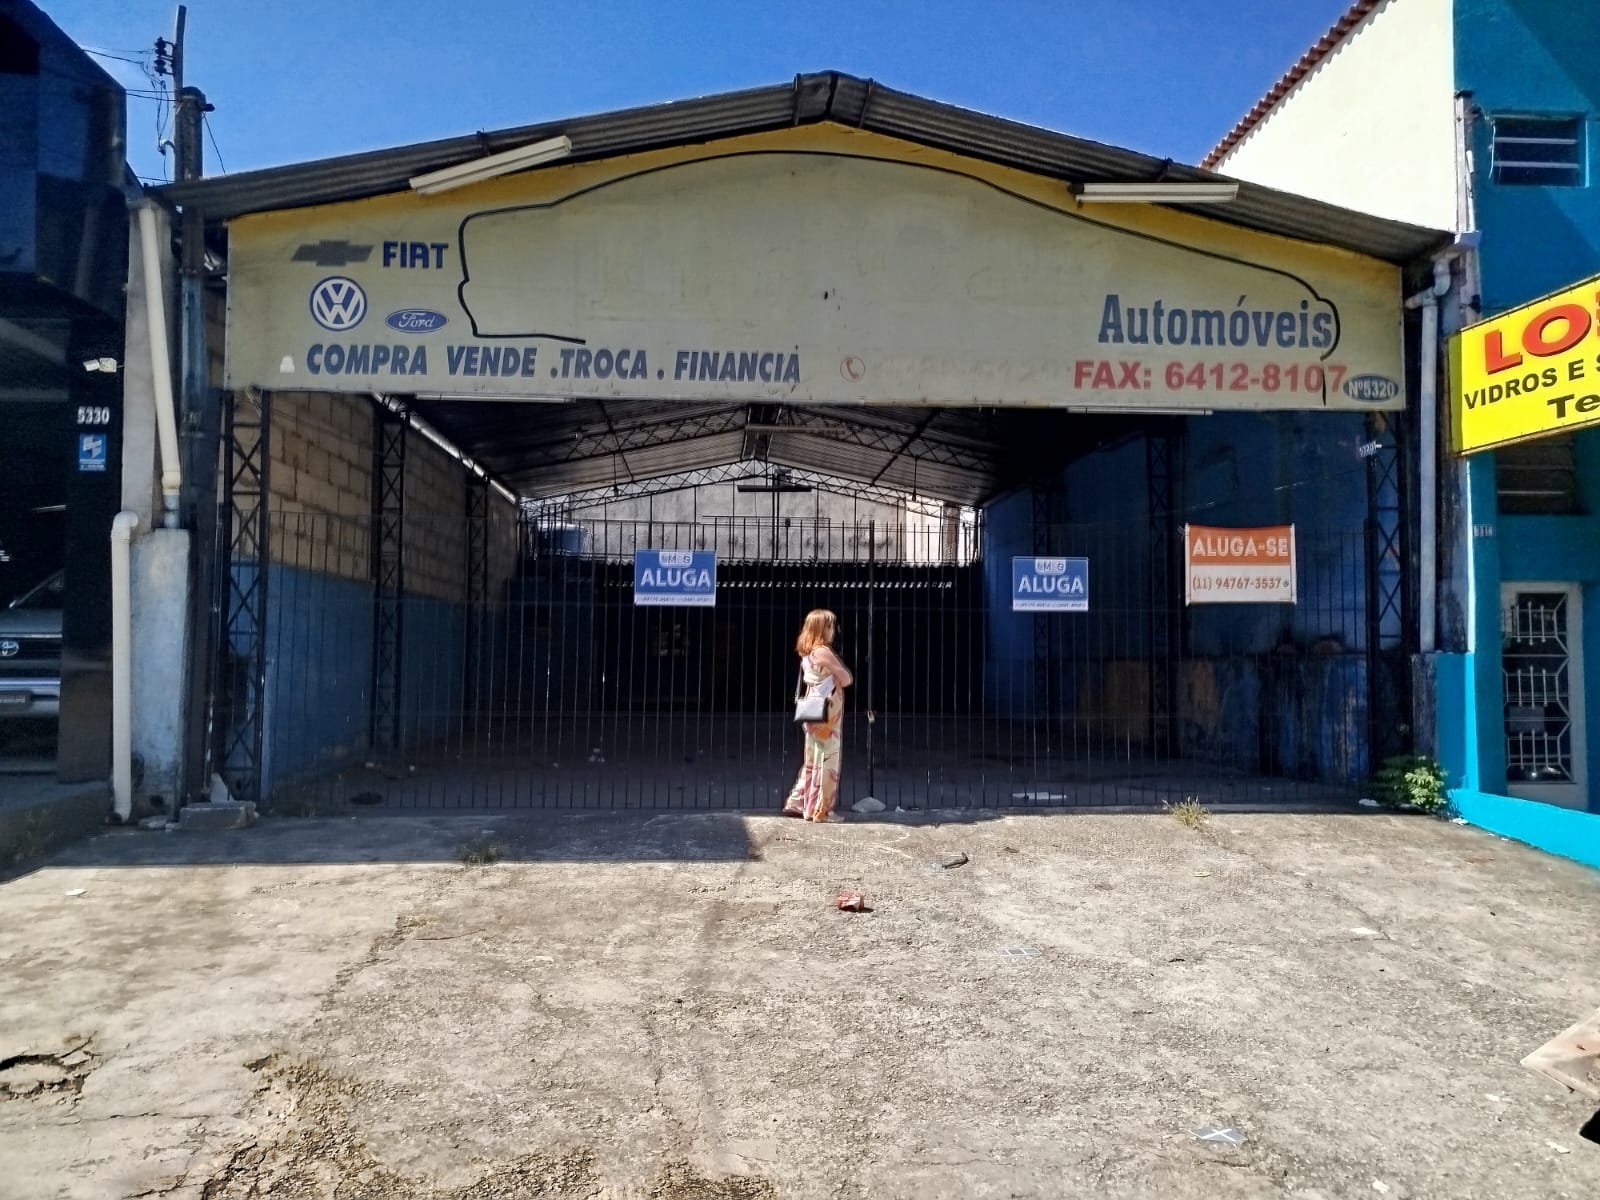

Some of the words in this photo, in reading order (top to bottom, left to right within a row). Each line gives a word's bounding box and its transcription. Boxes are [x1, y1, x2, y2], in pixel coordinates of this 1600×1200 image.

[382, 241, 449, 269] FIAT
[398, 312, 436, 328] Ford
[1098, 294, 1333, 350] Automóveis
[1484, 289, 1600, 375] LO
[306, 344, 428, 376] COMPRA
[447, 346, 537, 378] VENDE
[674, 351, 801, 384] FINANCIA
[1073, 361, 1152, 391] FAX:
[1165, 362, 1348, 394] 6412-8107
[1463, 367, 1558, 410] VIDROS
[1568, 358, 1585, 381] E
[1192, 536, 1289, 556] ALUGA-SE
[640, 568, 712, 588] ALUGA
[1018, 575, 1084, 594] ALUGA
[1192, 575, 1213, 591] (11)
